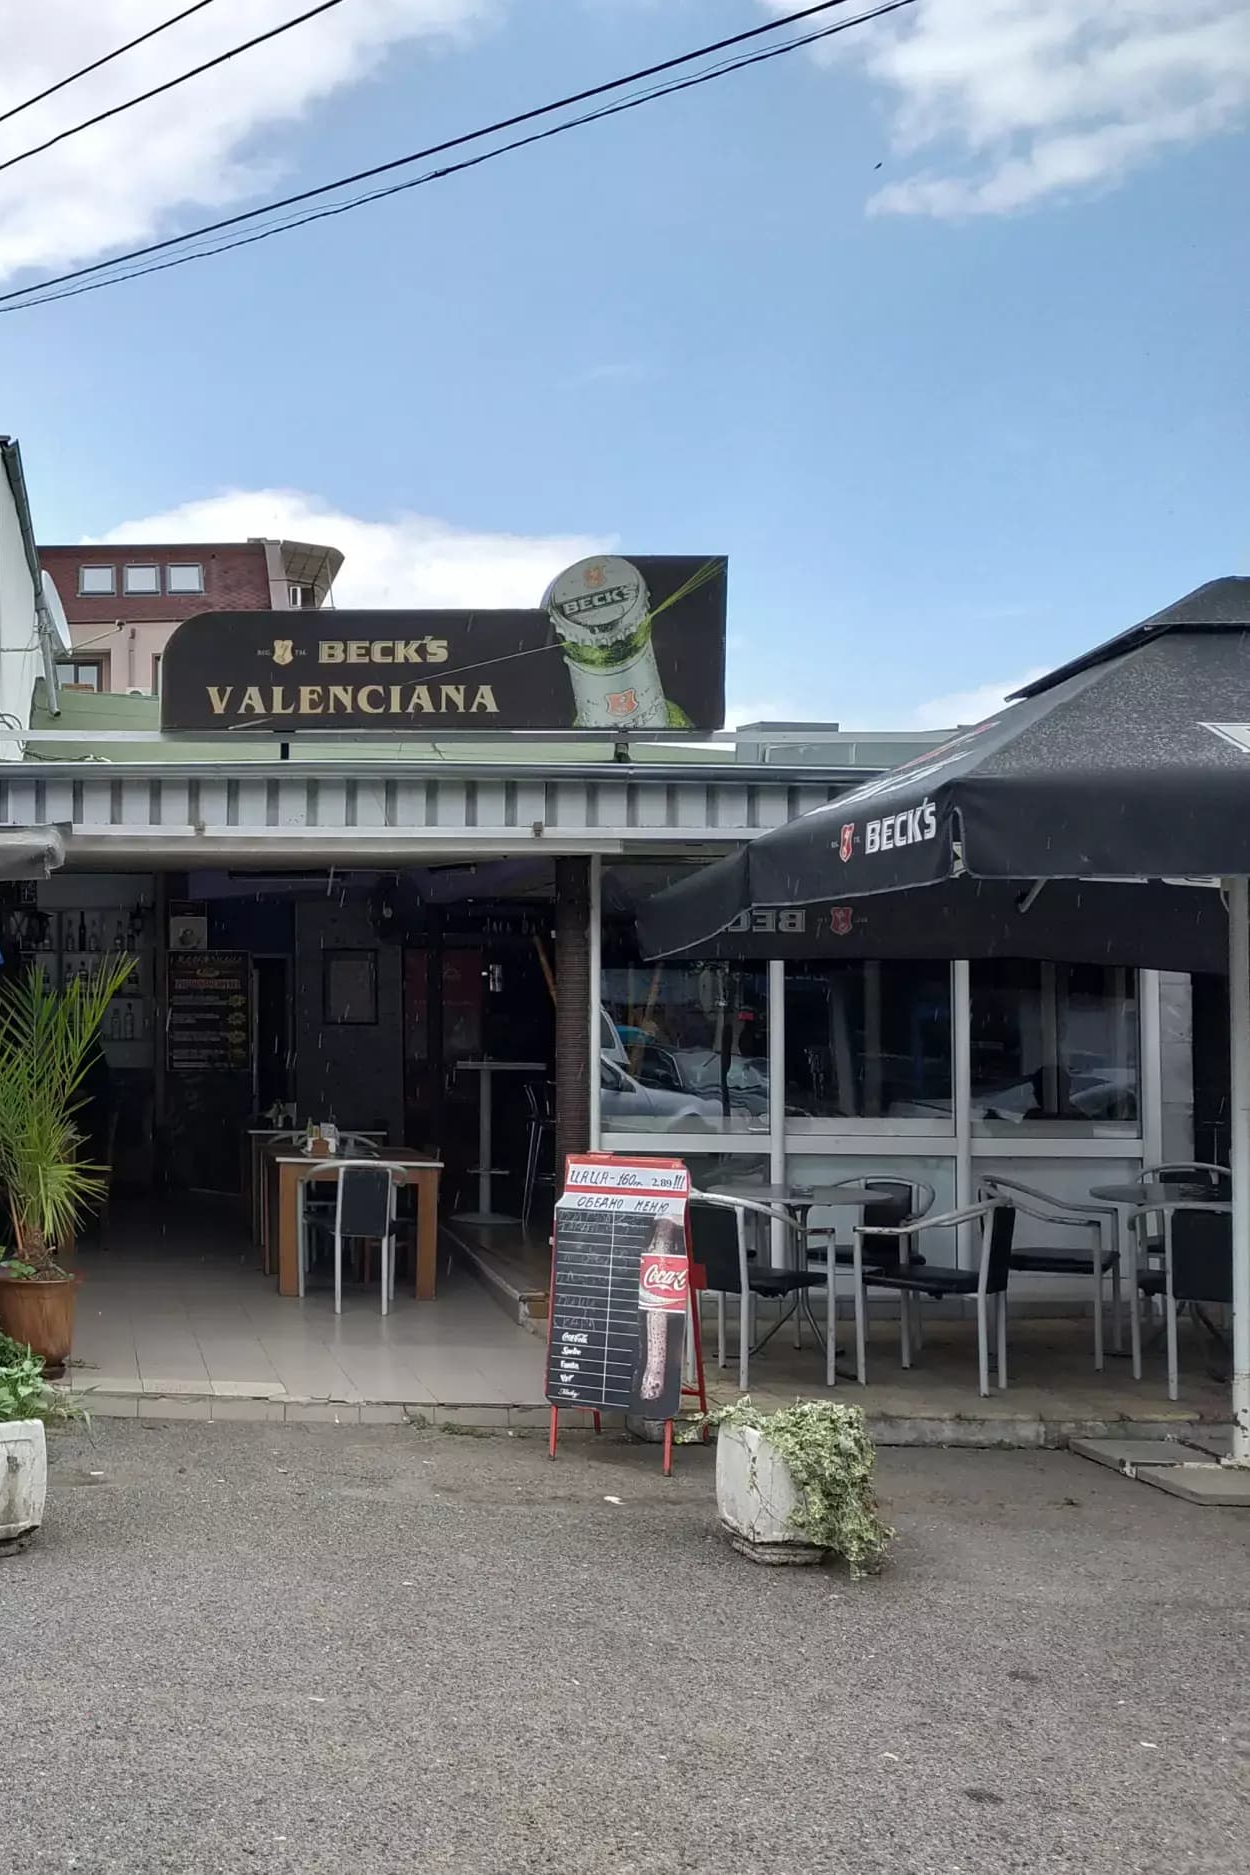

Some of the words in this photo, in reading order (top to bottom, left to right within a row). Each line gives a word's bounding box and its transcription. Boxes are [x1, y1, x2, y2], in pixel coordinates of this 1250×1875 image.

[563, 584, 639, 615] BECK'S
[318, 635, 449, 664] BECK'S
[206, 685, 500, 714] VALENCIANA
[865, 796, 937, 855] BECK'S
[577, 1196, 624, 1209] ОБЕДНО
[634, 1200, 670, 1212] МЕНЮ
